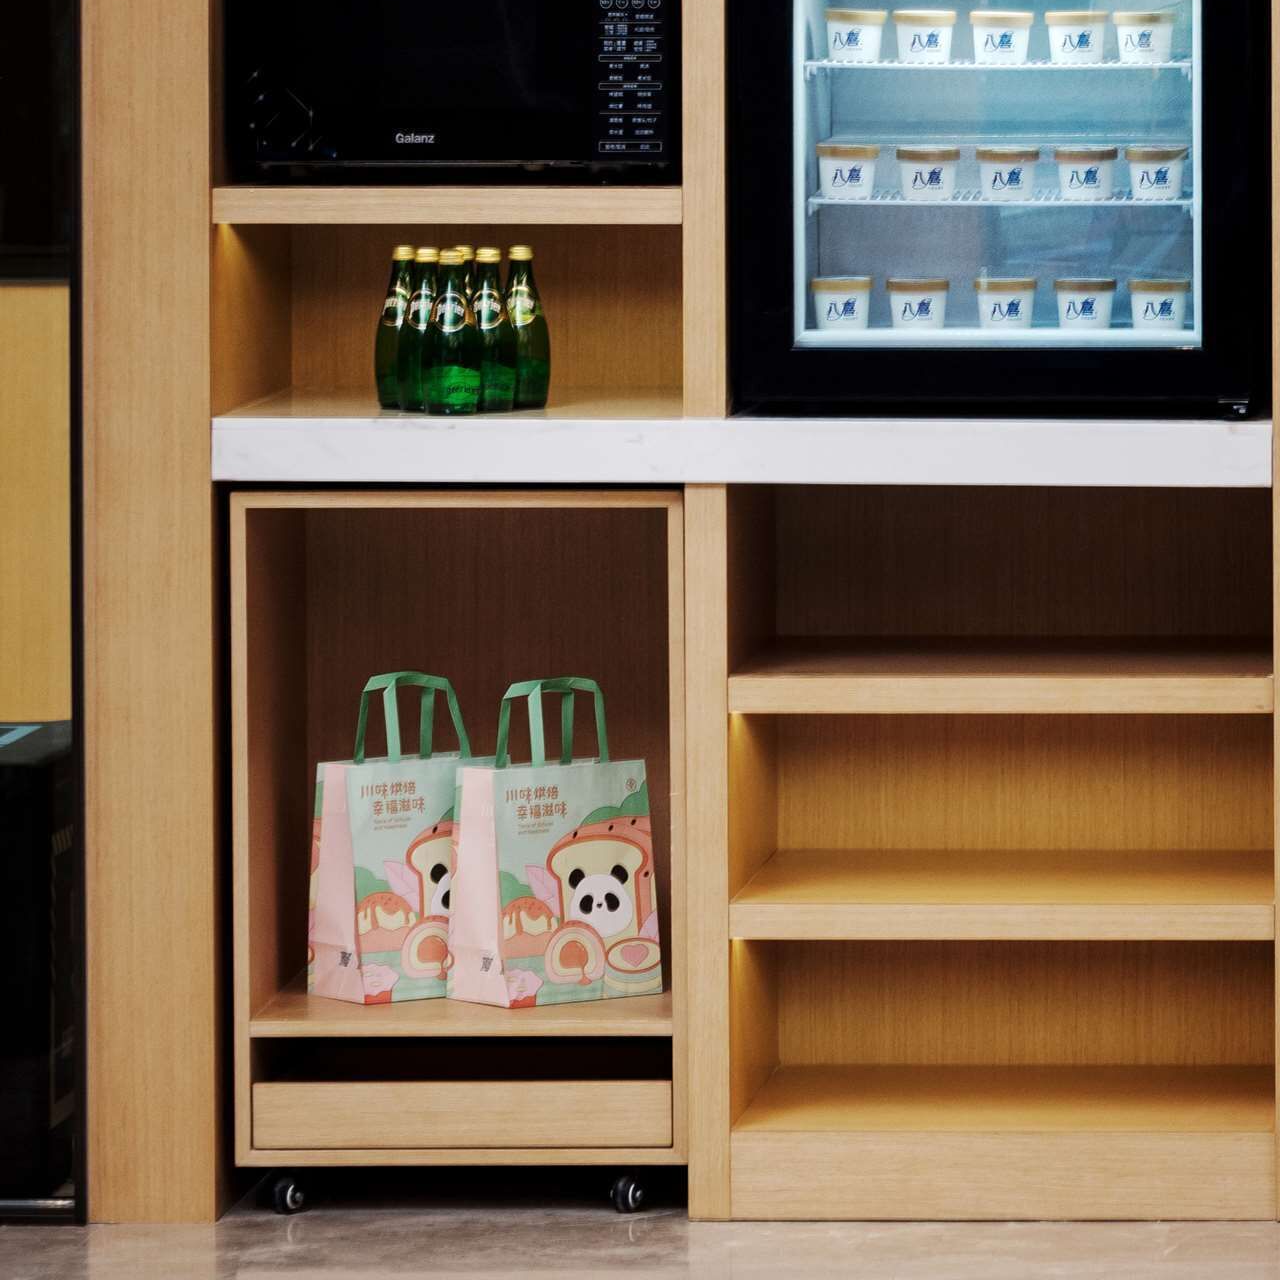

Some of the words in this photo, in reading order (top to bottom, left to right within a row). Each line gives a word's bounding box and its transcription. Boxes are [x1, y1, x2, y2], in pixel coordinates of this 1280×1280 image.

[395, 132, 434, 144] Galanz
[373, 796, 426, 817] 幸福滋味
[517, 801, 568, 821] 幸福滋味
